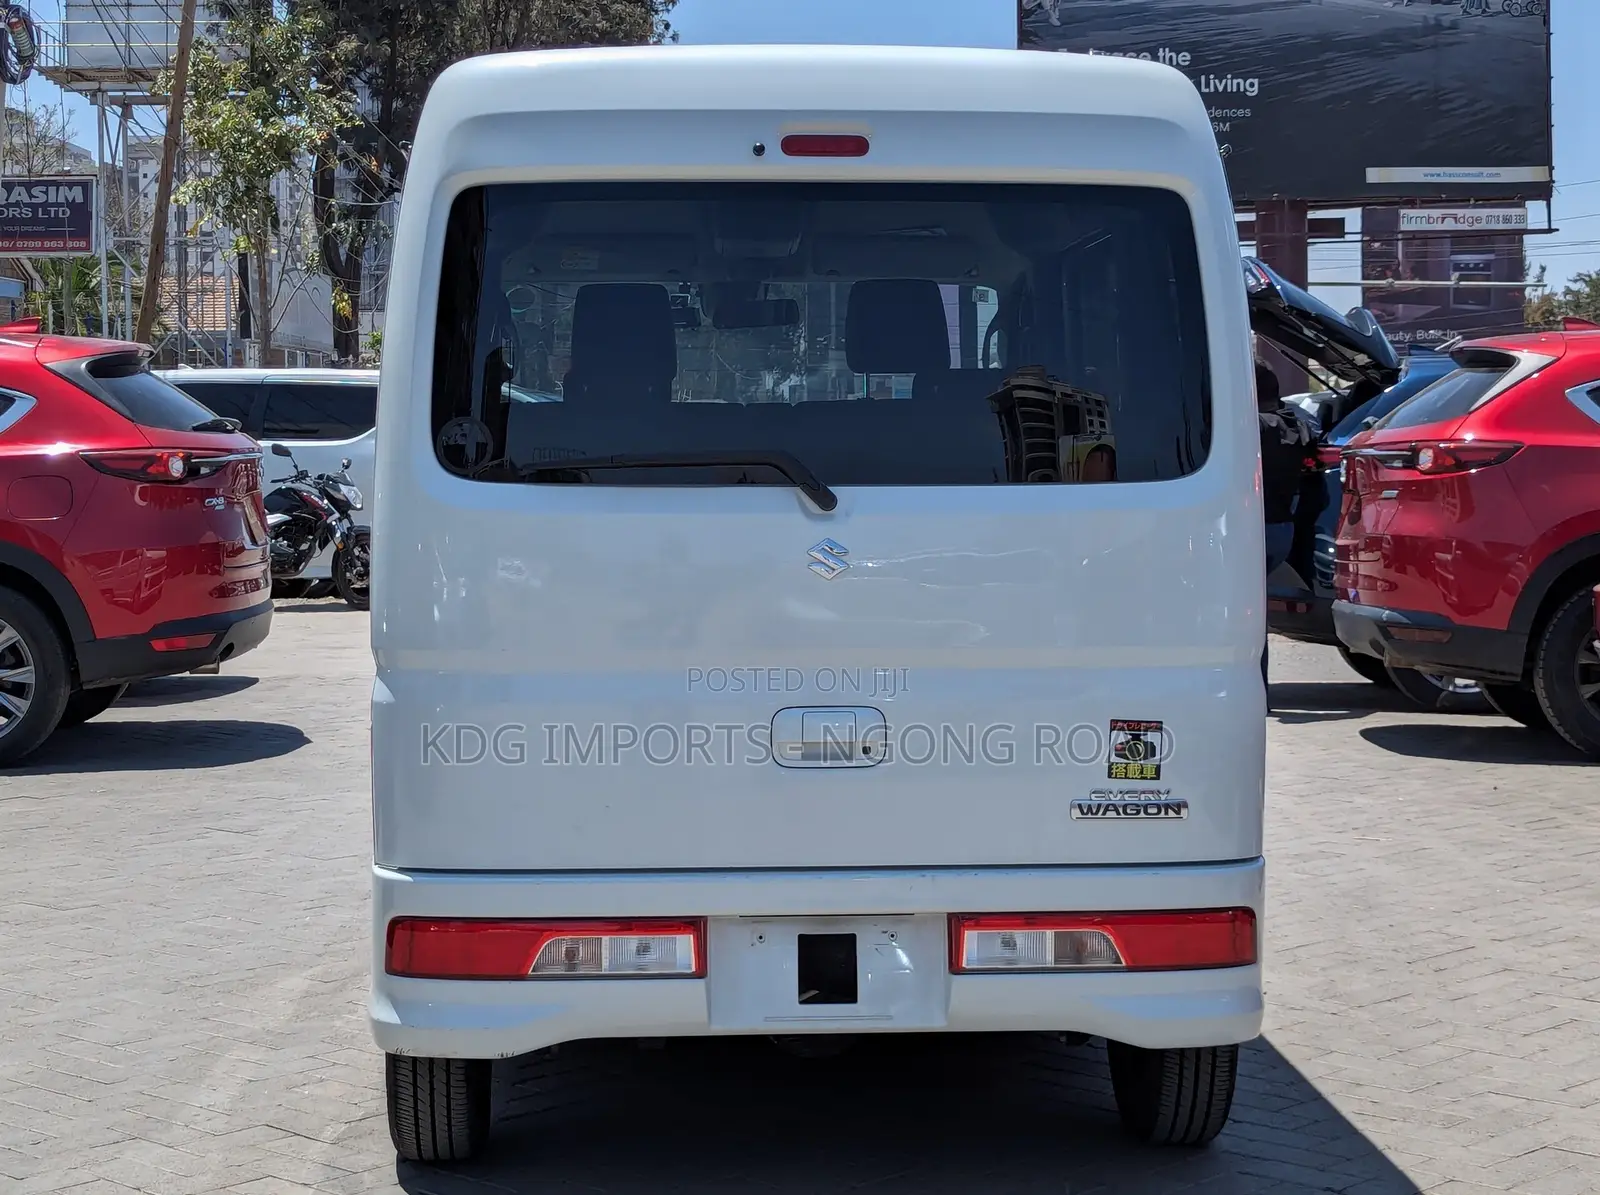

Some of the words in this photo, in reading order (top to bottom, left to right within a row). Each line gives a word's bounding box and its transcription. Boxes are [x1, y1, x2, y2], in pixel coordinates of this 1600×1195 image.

[1158, 48, 1192, 66] the
[1200, 74, 1259, 96] Living
[38, 207, 71, 218] LTD
[1111, 763, 1157, 779] 搭載車
[1090, 788, 1172, 801] EVERY
[1077, 803, 1182, 816] WAGON
